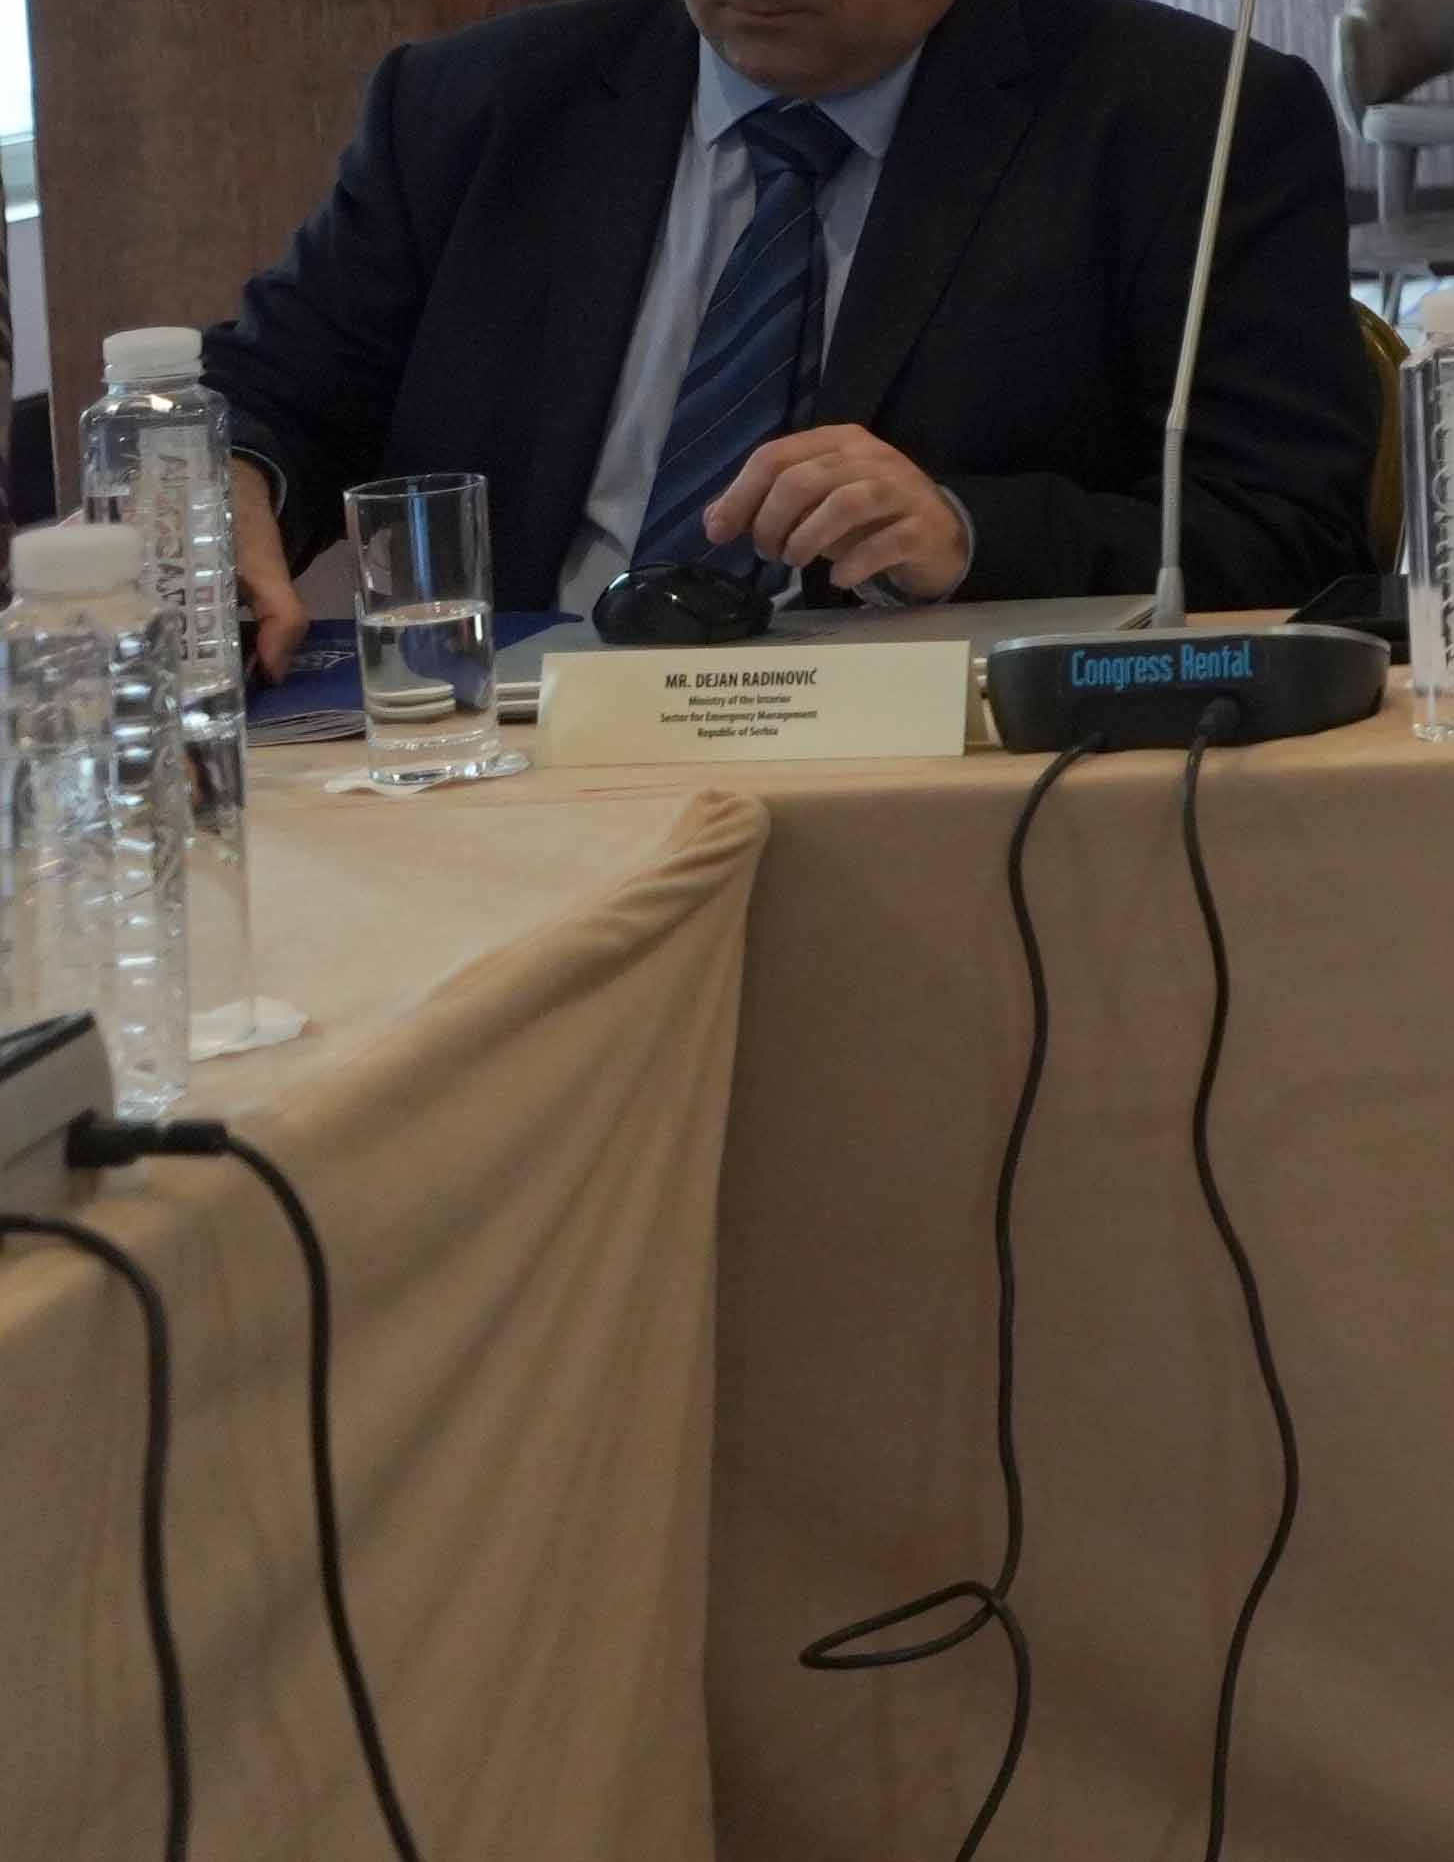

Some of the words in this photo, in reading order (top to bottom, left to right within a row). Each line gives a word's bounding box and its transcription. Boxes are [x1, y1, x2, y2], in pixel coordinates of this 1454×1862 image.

[1071, 649, 1175, 690] Congress
[1180, 640, 1252, 682] Rental
[665, 673, 691, 689] MR.
[695, 672, 738, 688] DEJAN
[742, 667, 818, 687] RADINOVIĆ
[688, 695, 725, 707] Ministry
[727, 694, 738, 705] of
[739, 694, 755, 705] the
[660, 712, 689, 723] Sector
[690, 711, 704, 722] for
[705, 710, 755, 723] Emergency
[757, 710, 817, 721] Management
[697, 727, 736, 738] Republic
[738, 726, 748, 737] of
[750, 726, 779, 737] Serbia
